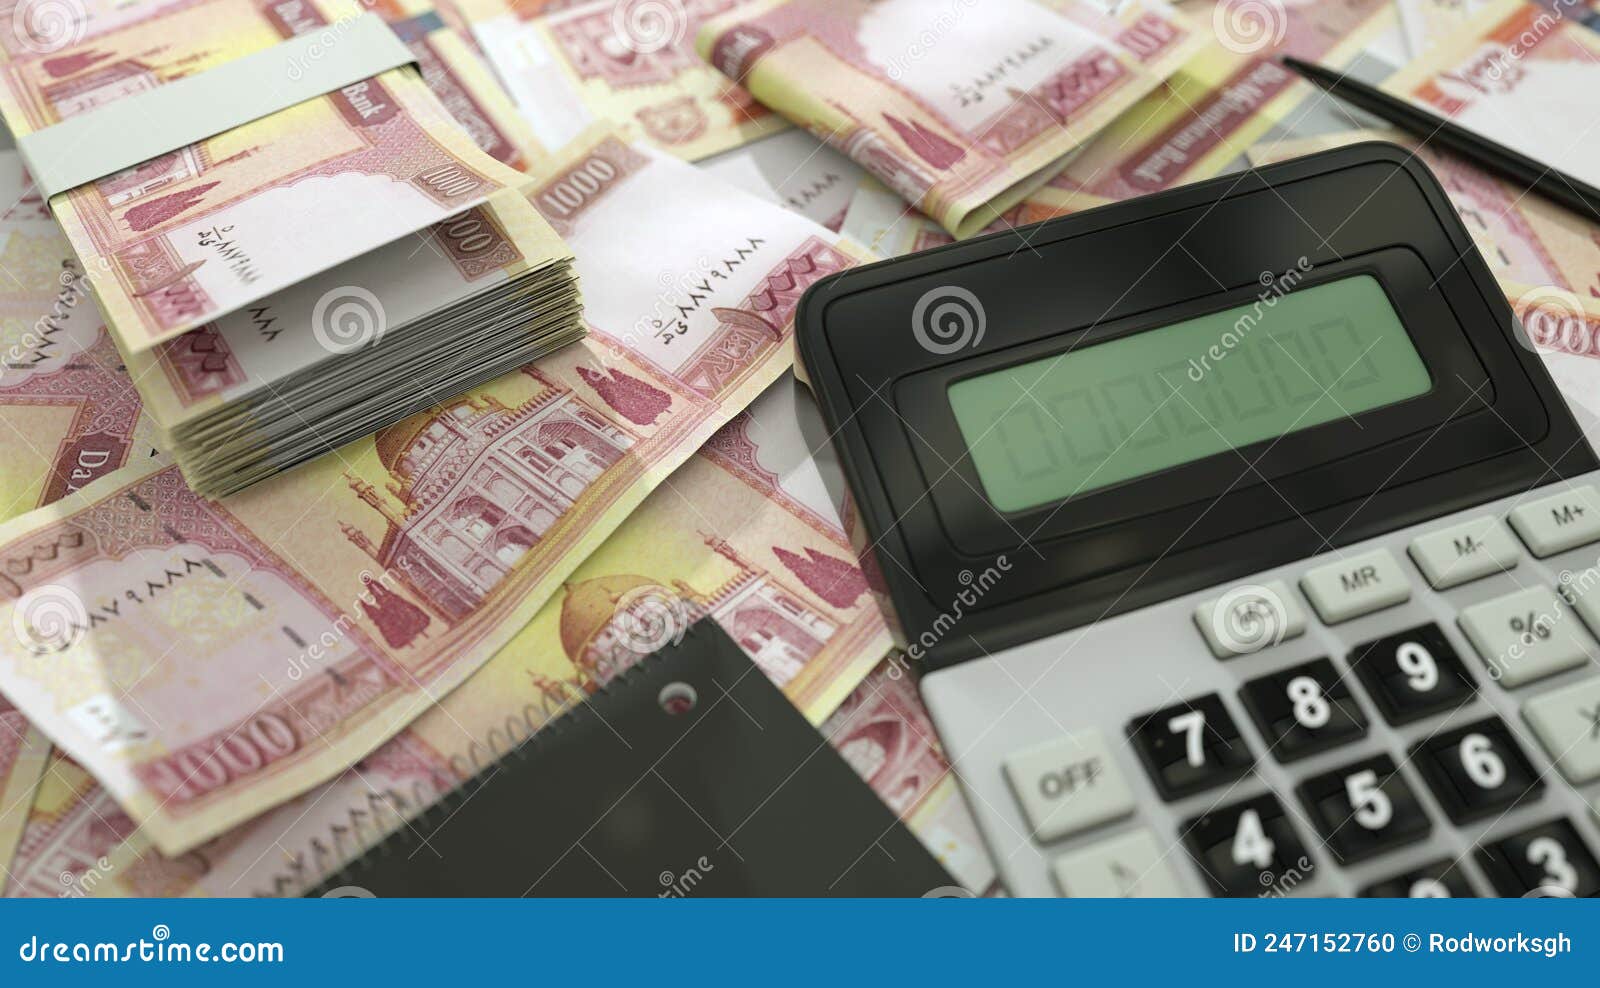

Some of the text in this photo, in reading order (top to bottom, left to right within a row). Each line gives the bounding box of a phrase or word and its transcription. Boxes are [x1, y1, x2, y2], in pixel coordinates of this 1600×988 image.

[423, 166, 480, 197] 1000
[543, 158, 615, 215] 1000
[1552, 504, 1584, 526] M+
[1453, 535, 1484, 558] M-
[1340, 566, 1381, 592] MR
[1509, 612, 1552, 641] %
[1396, 642, 1439, 692] 9
[1287, 676, 1330, 729] 8
[150, 711, 297, 800] 1000
[1168, 710, 1206, 767] 7
[1459, 733, 1506, 789] 6
[1038, 757, 1102, 800] OFF
[1345, 769, 1393, 829] 5
[1232, 808, 1274, 868] 4
[1526, 837, 1579, 898] 3
